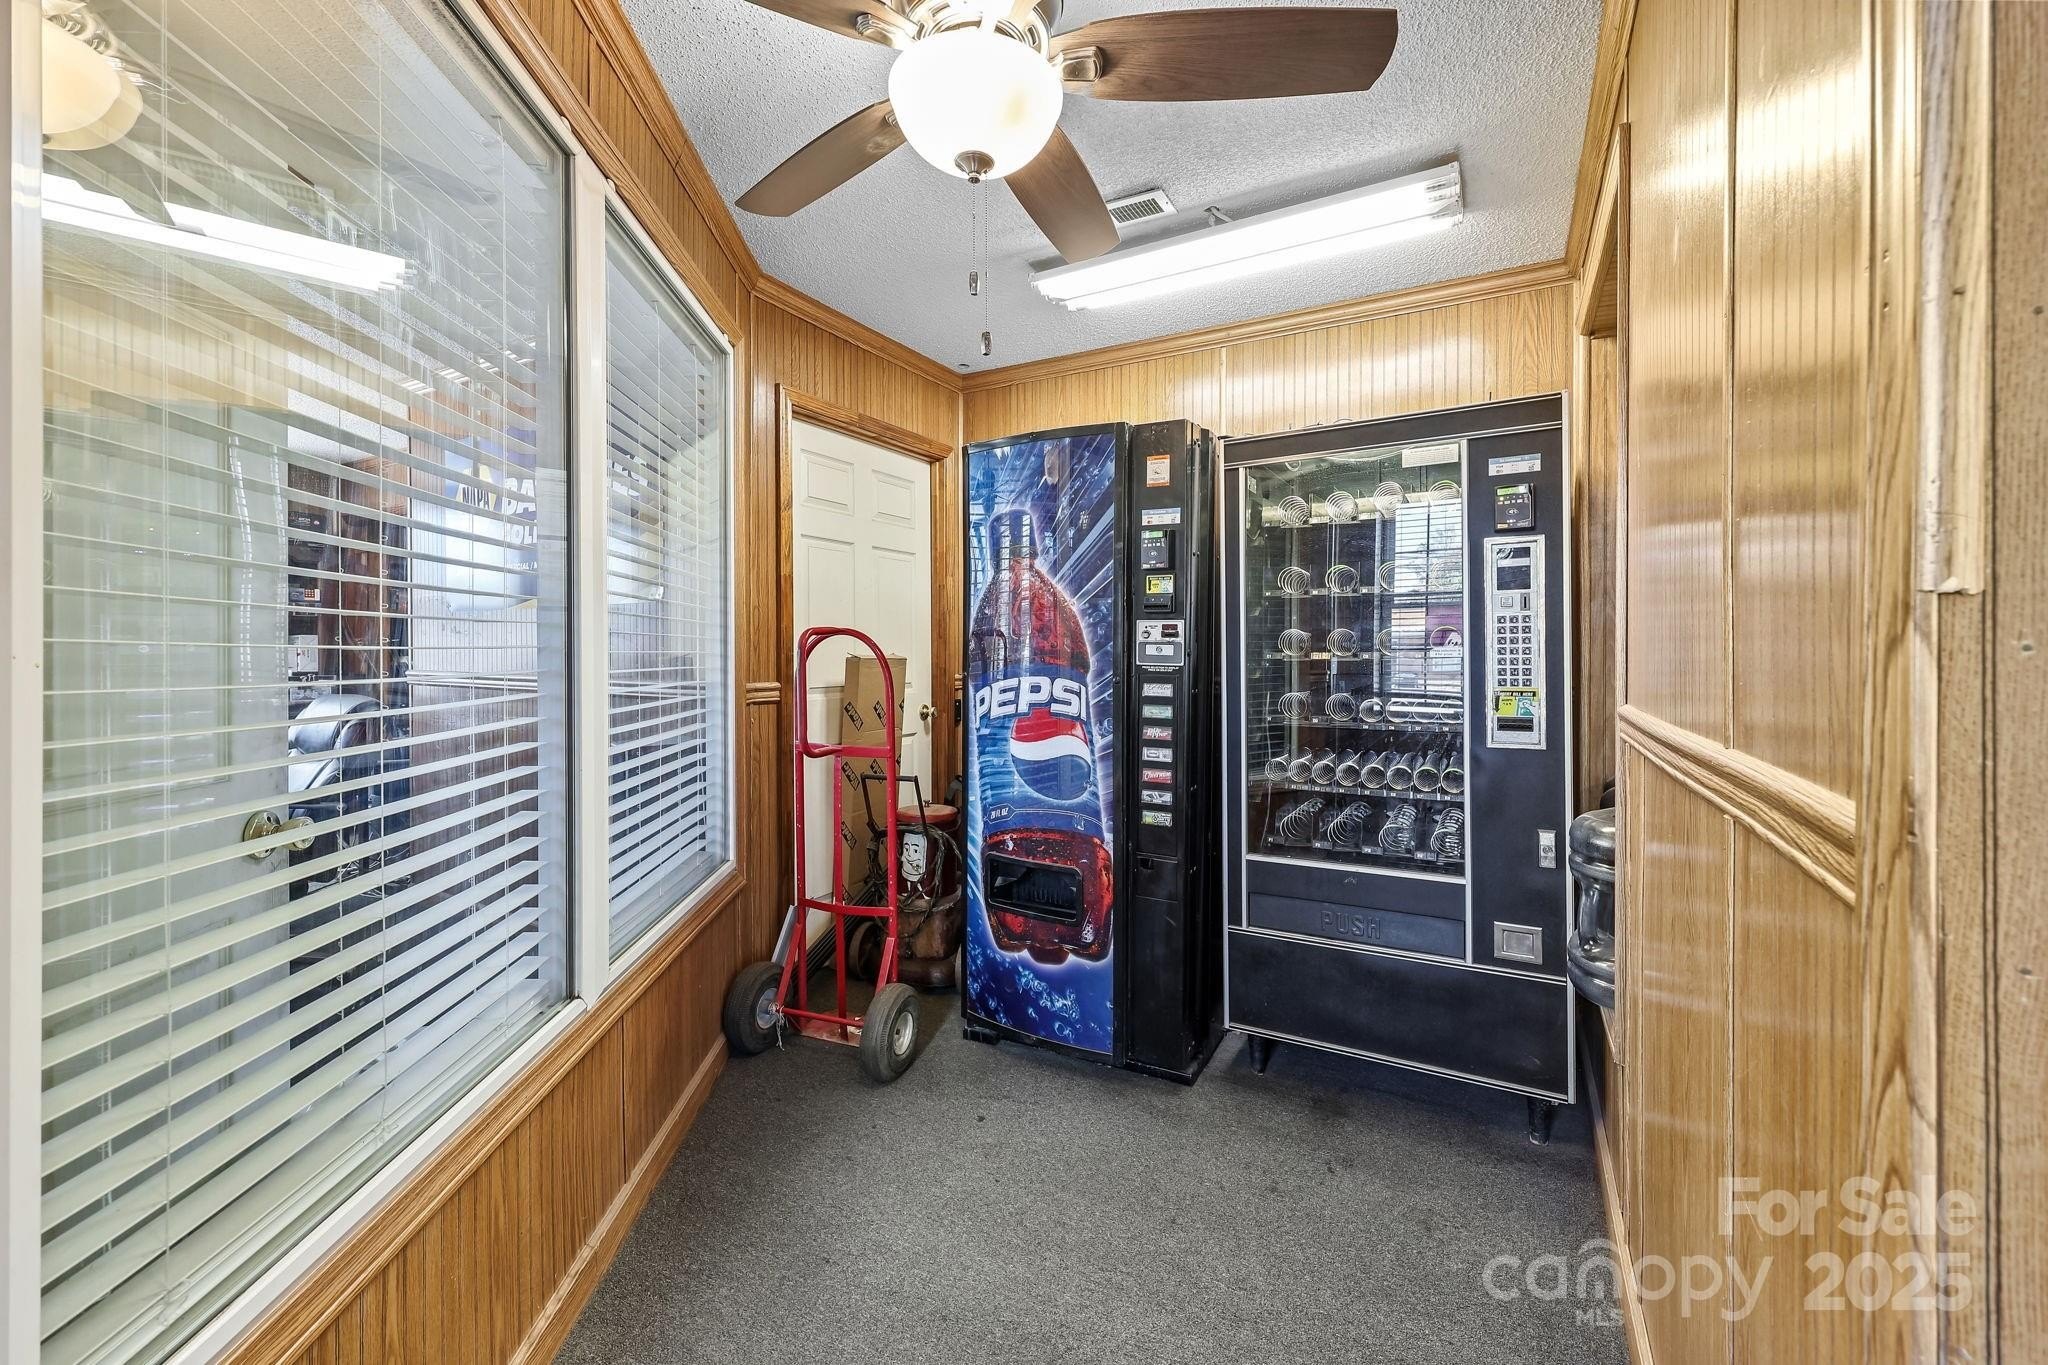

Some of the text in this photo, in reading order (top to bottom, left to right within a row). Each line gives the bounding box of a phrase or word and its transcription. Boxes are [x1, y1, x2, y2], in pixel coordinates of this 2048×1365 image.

[462, 485, 490, 511] NAPA
[975, 676, 1087, 729] PEPSI
[1320, 910, 1382, 940] PUSH
